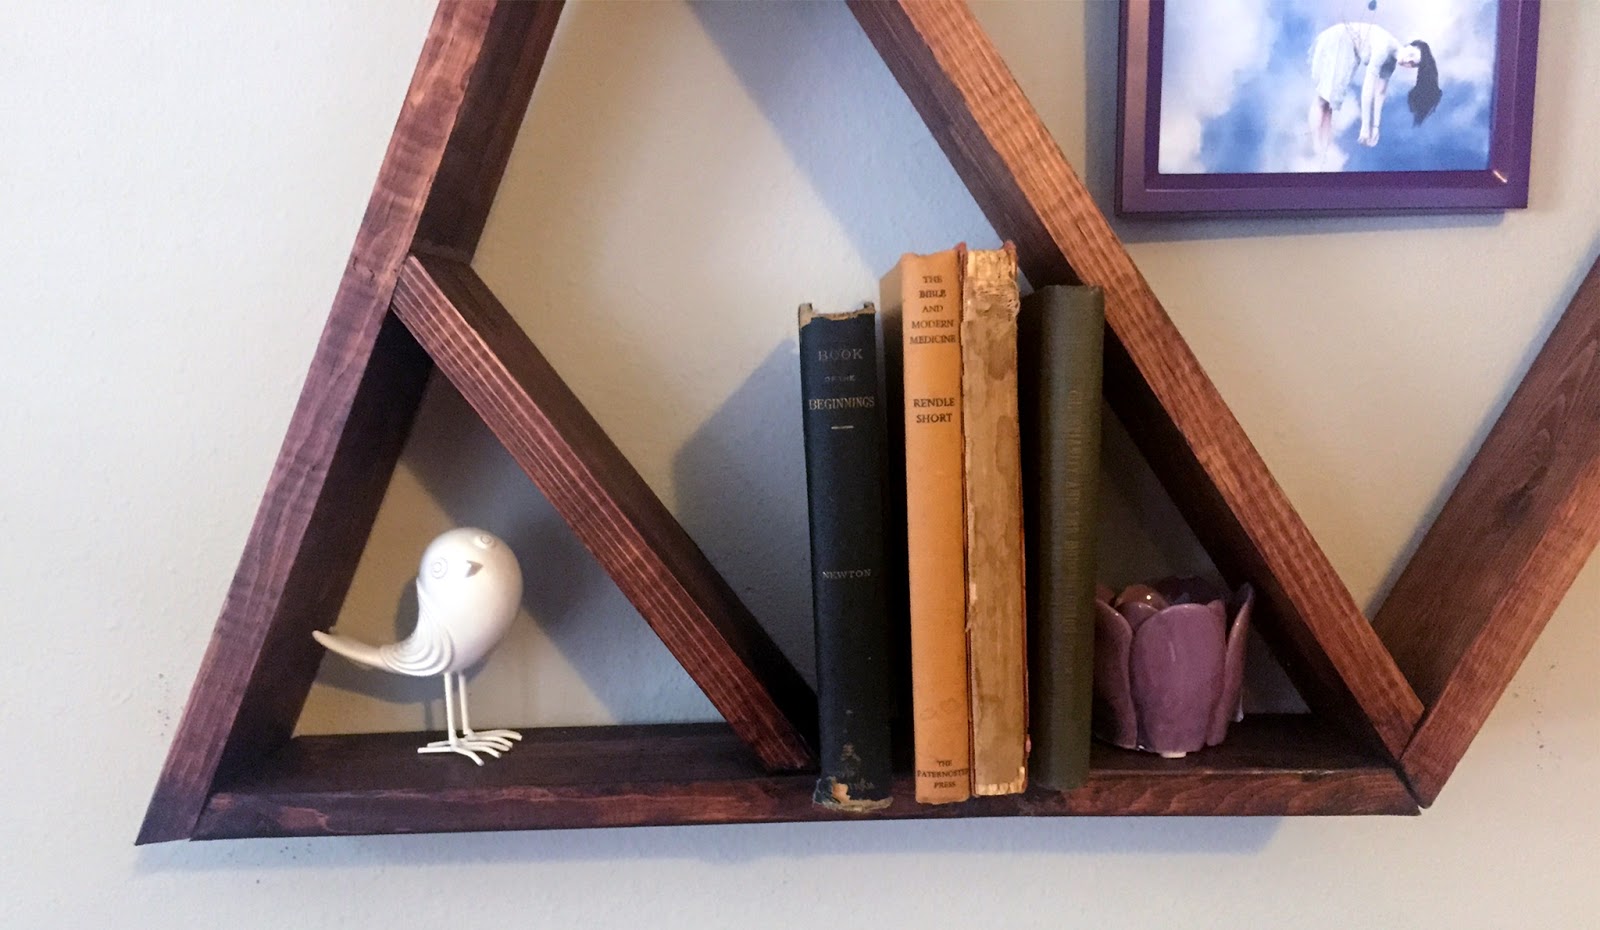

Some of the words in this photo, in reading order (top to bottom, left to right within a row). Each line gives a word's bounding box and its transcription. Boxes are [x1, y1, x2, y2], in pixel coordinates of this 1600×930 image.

[922, 275, 943, 284] THE
[918, 289, 947, 299] BIBLE
[922, 304, 944, 313] AND
[911, 319, 954, 329] MODERN
[909, 334, 956, 345] MEDICINE
[818, 348, 863, 361] BOOK
[809, 396, 875, 410] BEGINNINGS
[913, 397, 955, 408] RENDLE
[916, 412, 952, 423] SHORT
[822, 568, 871, 579] NEWTON
[936, 759, 952, 767] THE
[934, 781, 956, 789] PRESS
